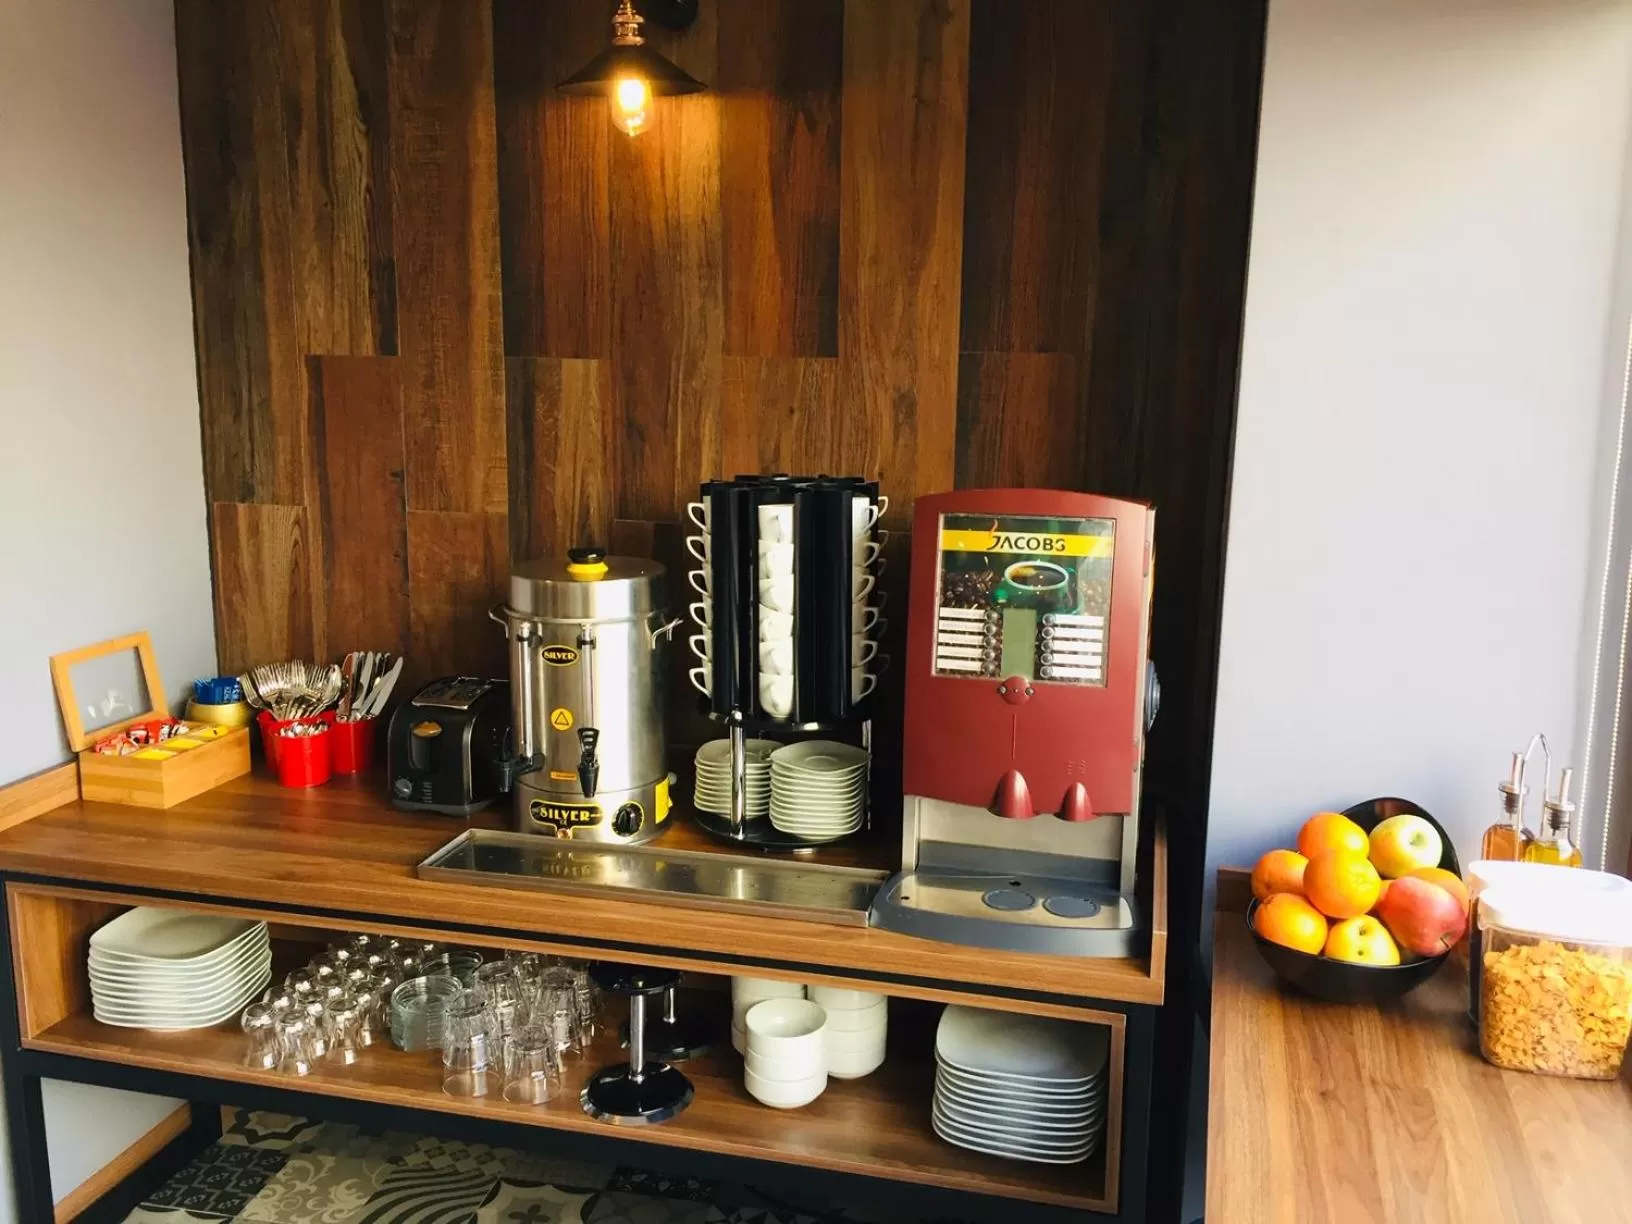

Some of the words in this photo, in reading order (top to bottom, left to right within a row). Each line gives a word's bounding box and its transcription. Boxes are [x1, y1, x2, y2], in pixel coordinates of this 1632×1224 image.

[986, 535, 1066, 552] JACOBS
[543, 651, 575, 660] SILVER
[540, 806, 591, 822] SILVER
